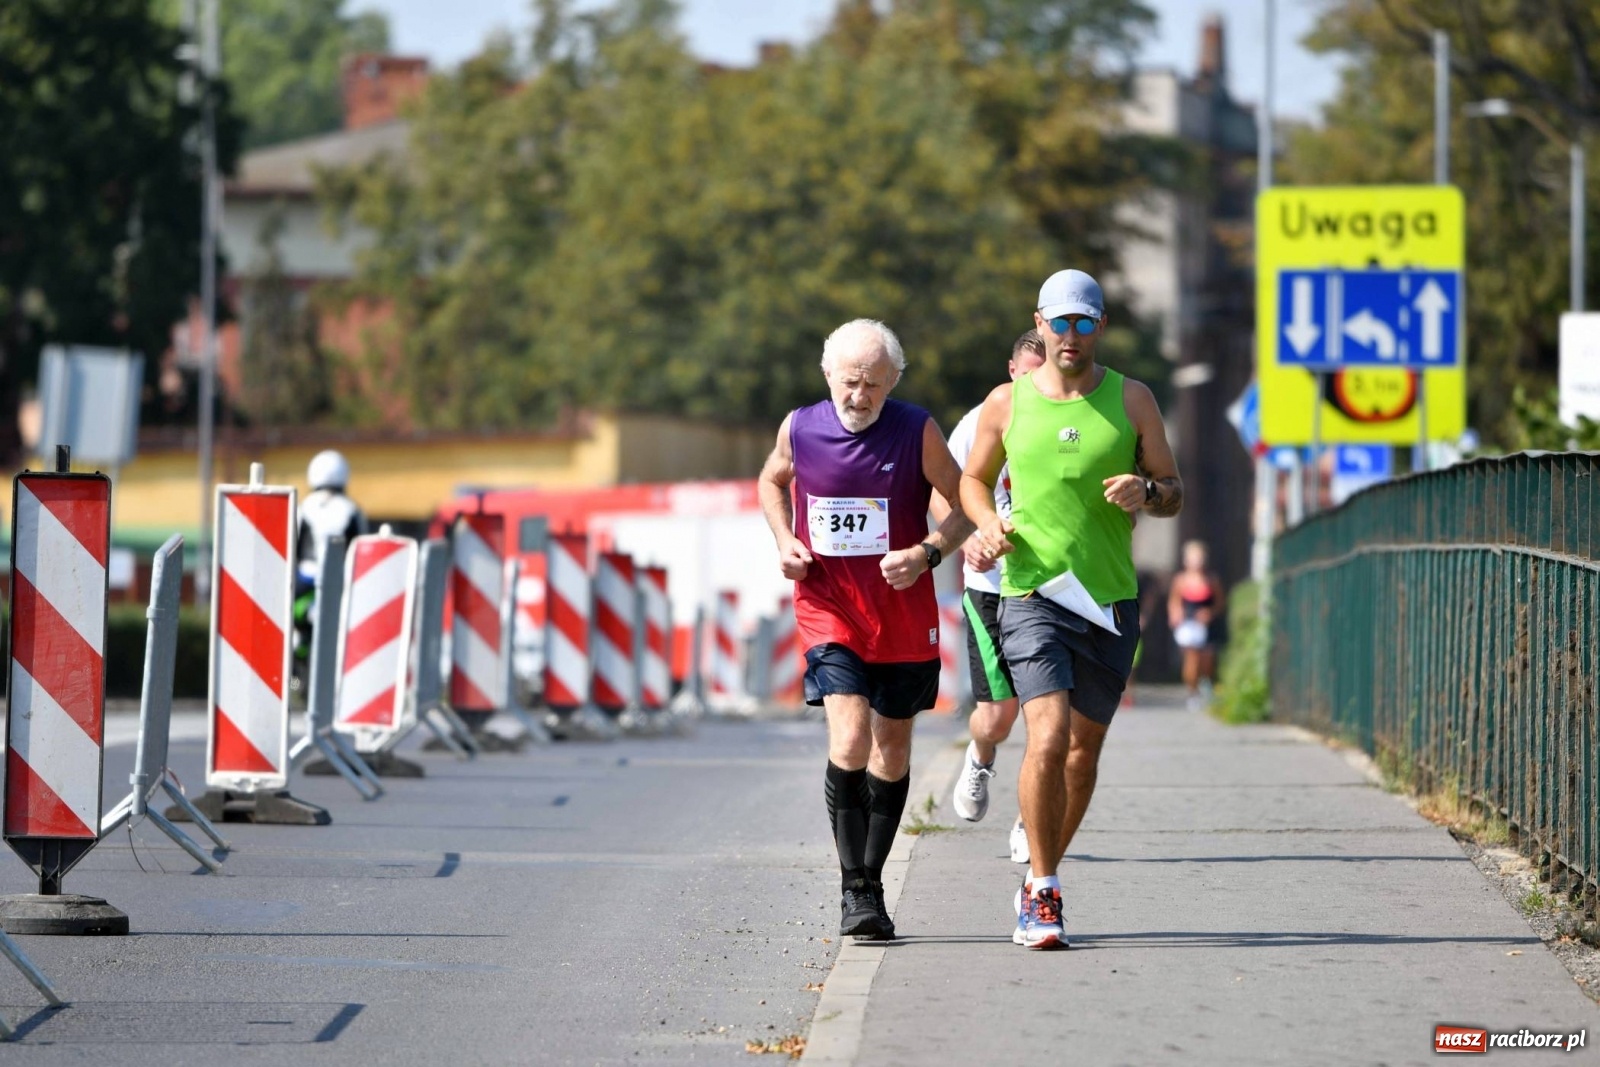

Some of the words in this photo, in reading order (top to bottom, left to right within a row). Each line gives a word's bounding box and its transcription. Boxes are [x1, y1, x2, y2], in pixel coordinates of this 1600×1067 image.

[1280, 201, 1438, 250] Uwaga
[881, 463, 894, 472] 4F
[830, 513, 868, 533] 347
